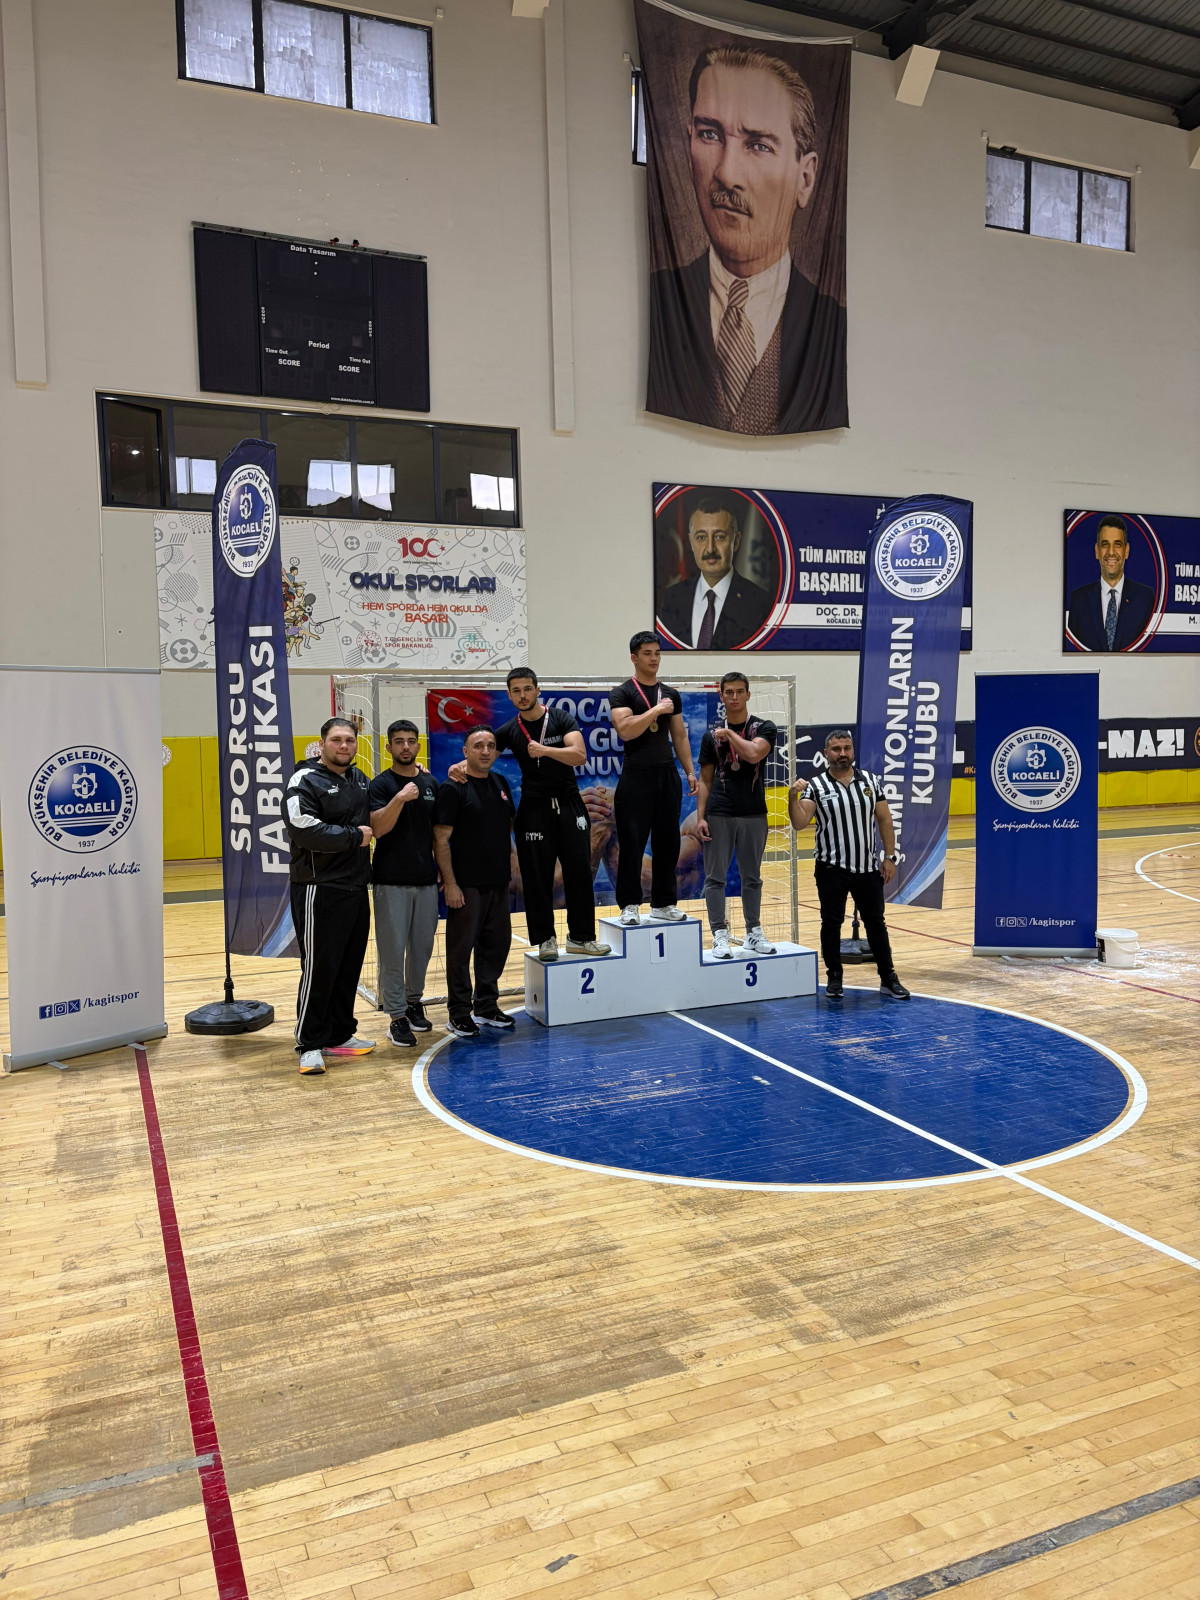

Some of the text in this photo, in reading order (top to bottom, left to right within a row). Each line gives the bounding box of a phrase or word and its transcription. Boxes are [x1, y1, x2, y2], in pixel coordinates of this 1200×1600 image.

[290, 244, 307, 253] Data
[308, 340, 330, 349] Period
[278, 358, 301, 367] SCORE
[338, 364, 360, 373] SCORE
[799, 545, 866, 565] TÜM ANTREN
[880, 528, 900, 587] BÜYÜKŞEHİR
[935, 531, 959, 587] KAĞITSPOR
[895, 556, 942, 567] KOCAELİ
[1174, 562, 1193, 577] TÜM
[349, 572, 496, 594] OKUL SPORLARI
[799, 571, 865, 596] BAŞARIL
[362, 602, 488, 613] HEM SPORDA HEM OKULDA
[816, 607, 840, 618] DOÇ.
[843, 608, 859, 617] DR.
[404, 613, 449, 624] BAŞARI
[1189, 615, 1198, 624] M.
[249, 626, 291, 874] FABRİKASI
[911, 681, 940, 805] KULÜBÜ
[229, 663, 251, 853] SPORCU
[997, 742, 1018, 800] BÜYÜKŞEHİR
[1016, 733, 1063, 748] BELEDİYE
[1054, 747, 1077, 799] KAĞITSPOR
[1012, 769, 1060, 781] KOCAELİ
[34, 750, 135, 842] BÜYÜKŞEHİR BELEDİYE KAĞITSPOR
[54, 800, 116, 816] KOCAELİ
[78, 840, 96, 848] 1937
[1028, 917, 1076, 928] /kagitspor
[654, 932, 665, 958] 1
[580, 967, 595, 995] 2
[745, 962, 758, 987] 3
[83, 990, 140, 1009] /kagitspor
